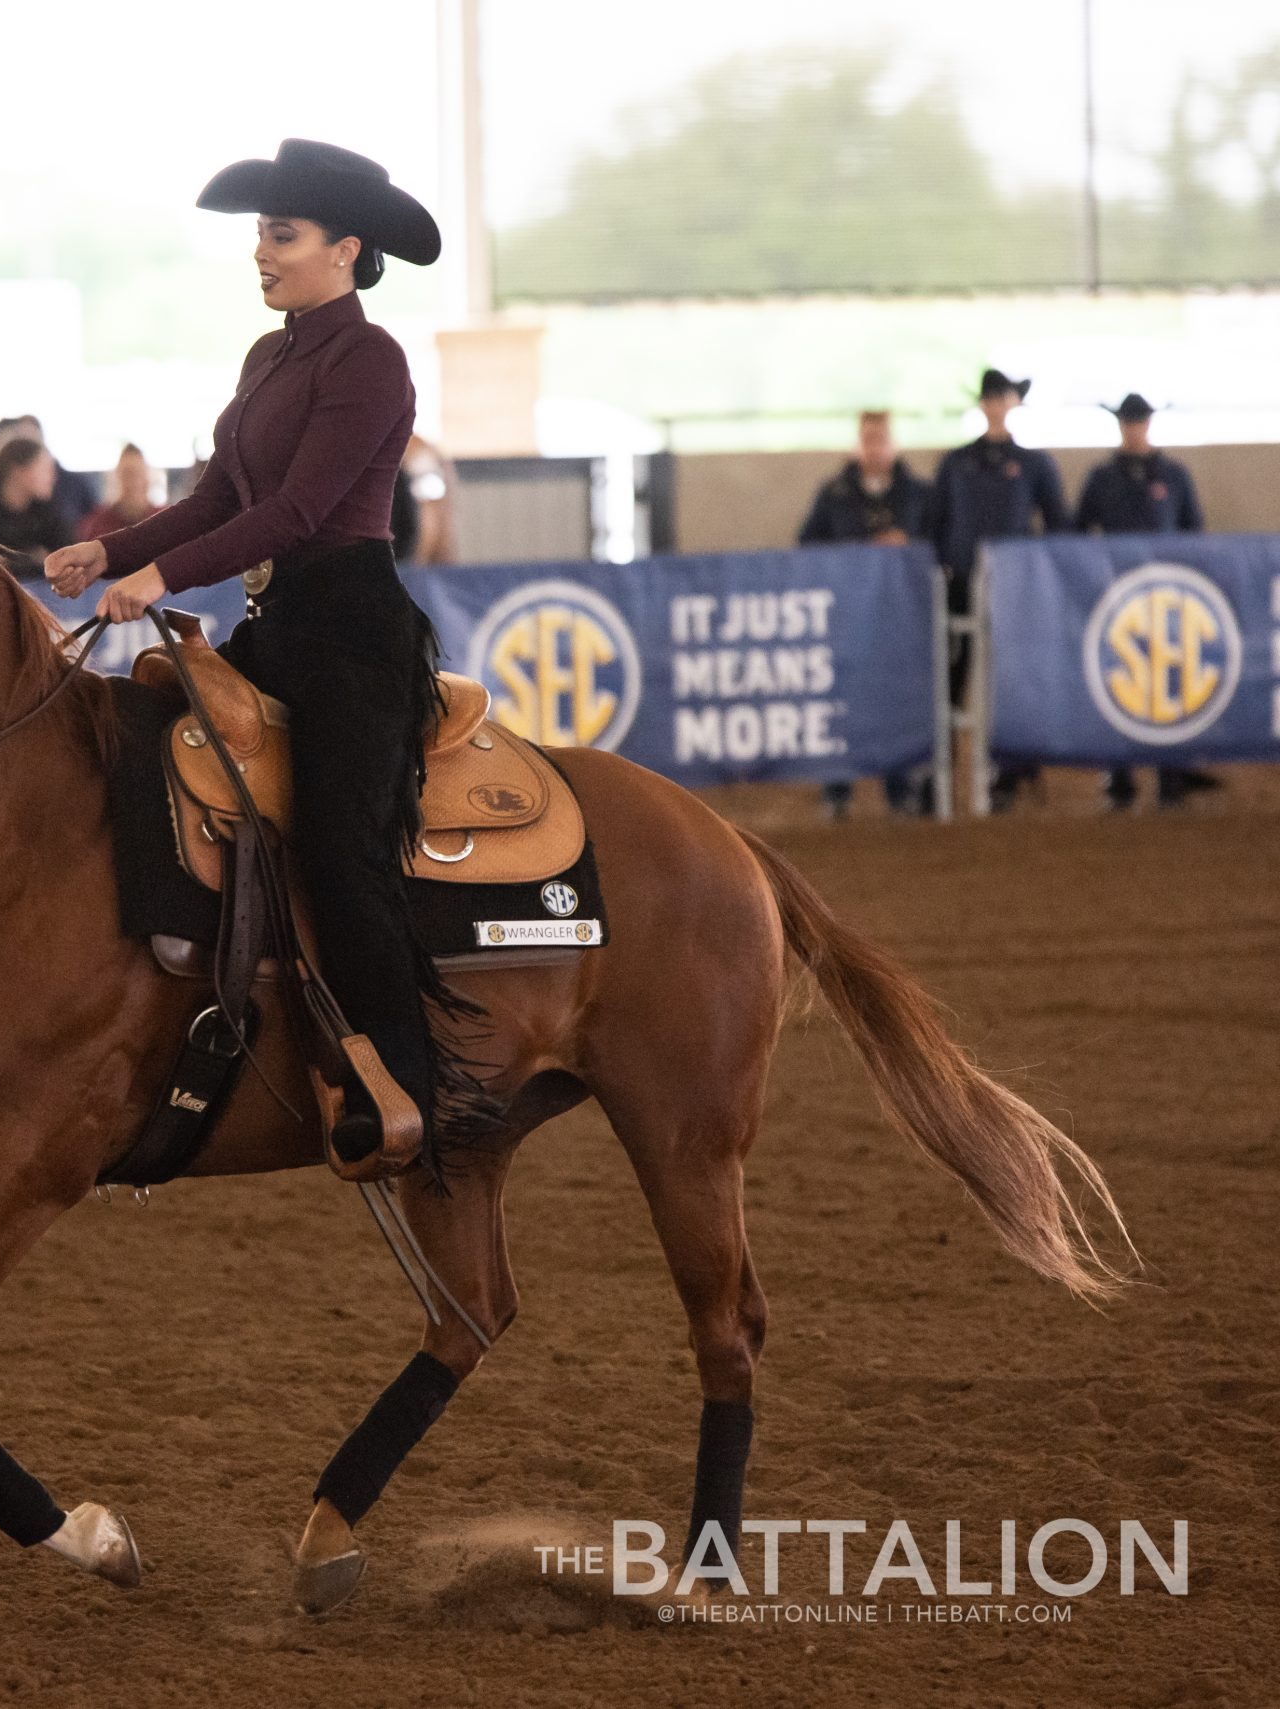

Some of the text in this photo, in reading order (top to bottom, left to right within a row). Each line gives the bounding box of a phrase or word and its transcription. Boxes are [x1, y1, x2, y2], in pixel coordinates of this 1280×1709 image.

[670, 589, 833, 644] IT JUST
[490, 604, 617, 747] SEC
[673, 647, 833, 699] MEANS
[1108, 587, 1218, 724] SEC
[543, 881, 576, 915] SEC
[506, 926, 574, 939] WRANGLER
